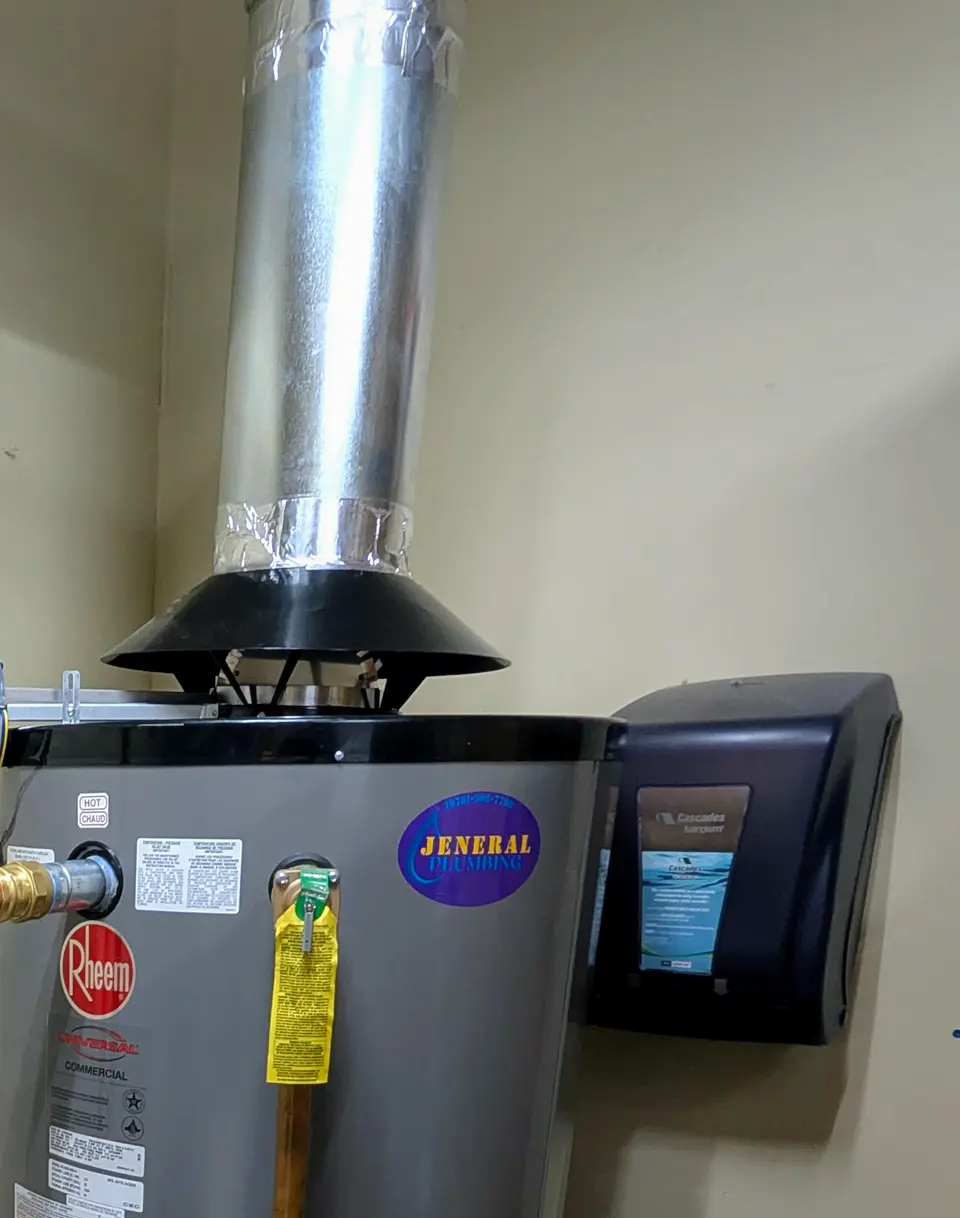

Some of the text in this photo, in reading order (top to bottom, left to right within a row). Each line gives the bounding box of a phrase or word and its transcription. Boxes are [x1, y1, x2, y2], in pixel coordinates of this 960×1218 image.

[84, 799, 101, 807] HOT
[82, 815, 105, 823] CHAUD
[677, 812, 725, 822] Cascades
[420, 834, 531, 856] JENERAL
[428, 855, 522, 872] PLUMBING
[69, 925, 129, 1001] Rheem
[57, 1031, 139, 1055] UNIVERSAL
[64, 1060, 128, 1081] COMMERCIAL
